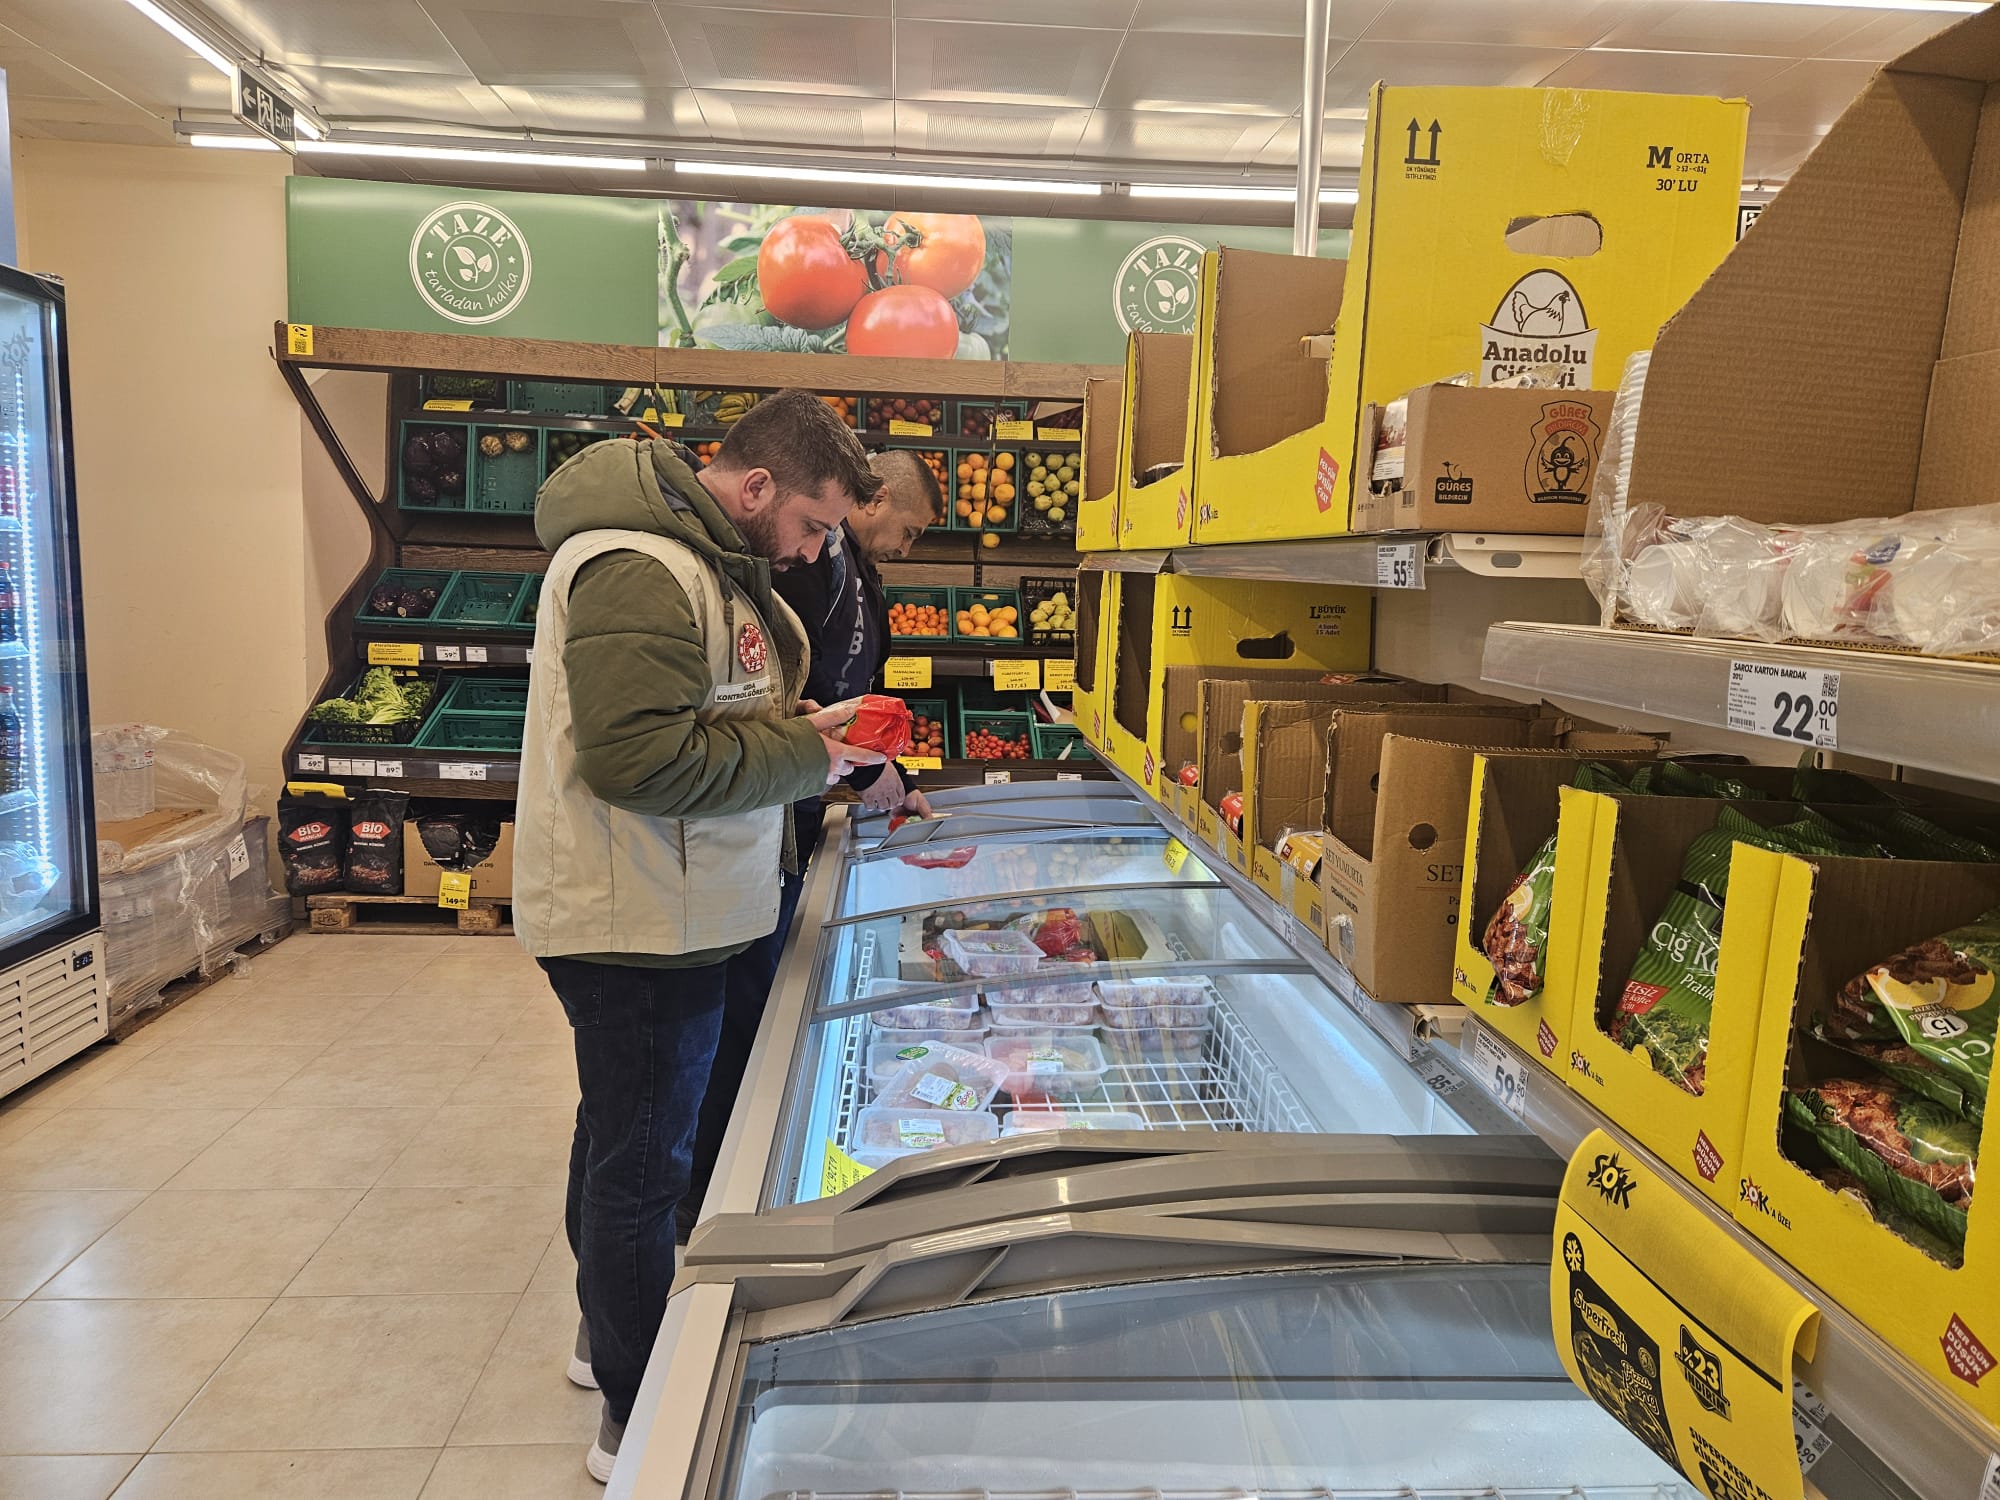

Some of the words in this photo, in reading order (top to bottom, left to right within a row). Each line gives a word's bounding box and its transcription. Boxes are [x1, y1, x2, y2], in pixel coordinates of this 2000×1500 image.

[275, 108, 292, 136] EXIT
[1646, 146, 1674, 168] M
[1676, 153, 1710, 164] ORTA
[429, 213, 513, 248] TAZE
[424, 269, 484, 311] tarladan
[486, 271, 519, 308] halka
[1482, 341, 1588, 364] Anadolu
[1437, 479, 1472, 492] GÜRES
[1733, 663, 1753, 673] SAROZ
[1754, 665, 1779, 676] KARTON
[1780, 669, 1808, 681] BARDAK
[1818, 718, 1831, 731] TL
[1335, 855, 1364, 888] YUMURTA
[1651, 922, 1691, 963] Çiğ
[1625, 981, 1659, 998] Etsiz
[1931, 1018, 1960, 1036] 15
[1698, 1136, 1709, 1152] HER
[1586, 1150, 1637, 1210] ŞOK
[1777, 1211, 1792, 1231] ÖZEL
[1573, 1288, 1628, 1355] SuperFresh
[1951, 1321, 1970, 1346] HER
[1946, 1331, 1983, 1376] DÜŞÜK
[1682, 1345, 1720, 1391] %23
[1685, 1367, 1728, 1416] İNDİRİM
[1689, 1426, 1754, 1491] SUPERFRESH
